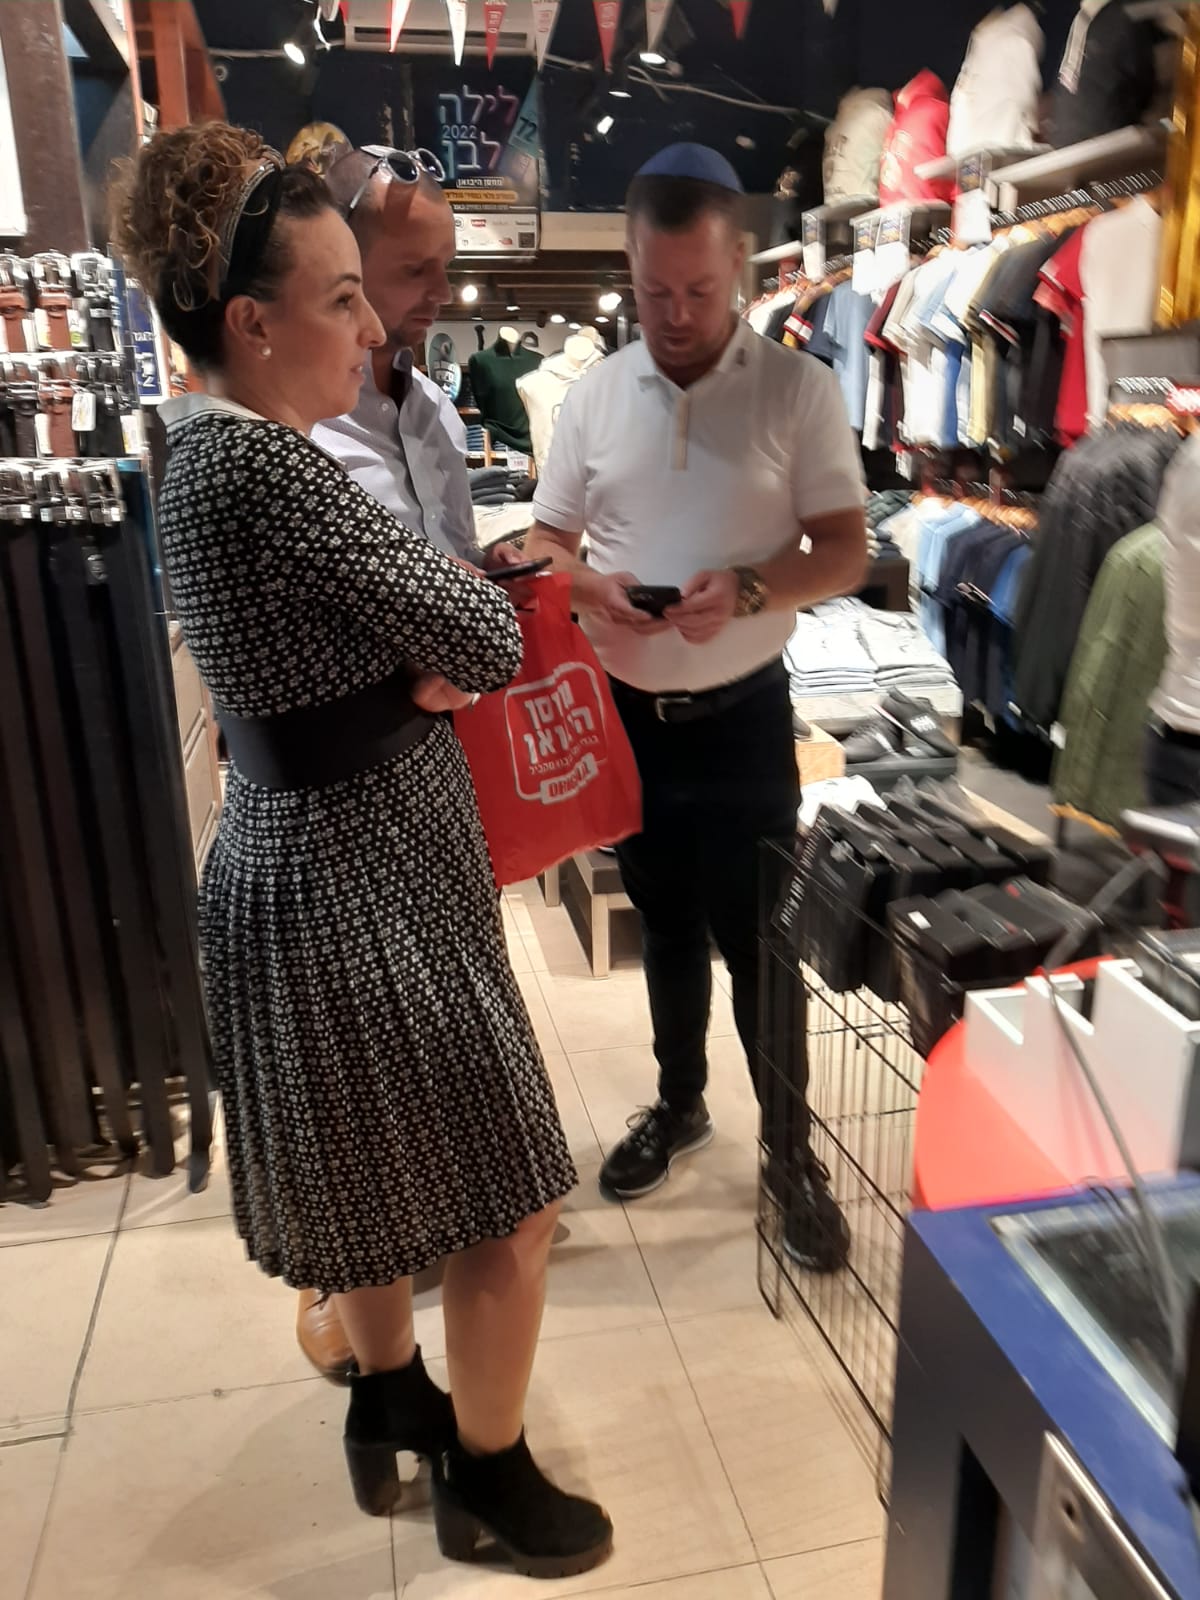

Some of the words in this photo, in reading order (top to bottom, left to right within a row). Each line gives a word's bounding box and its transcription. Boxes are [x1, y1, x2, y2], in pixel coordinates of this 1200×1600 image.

[438, 84, 519, 126] לילה
[442, 125, 477, 139] 2022
[516, 116, 538, 143] 72
[441, 131, 501, 179] לבן
[523, 706, 605, 765] היואן
